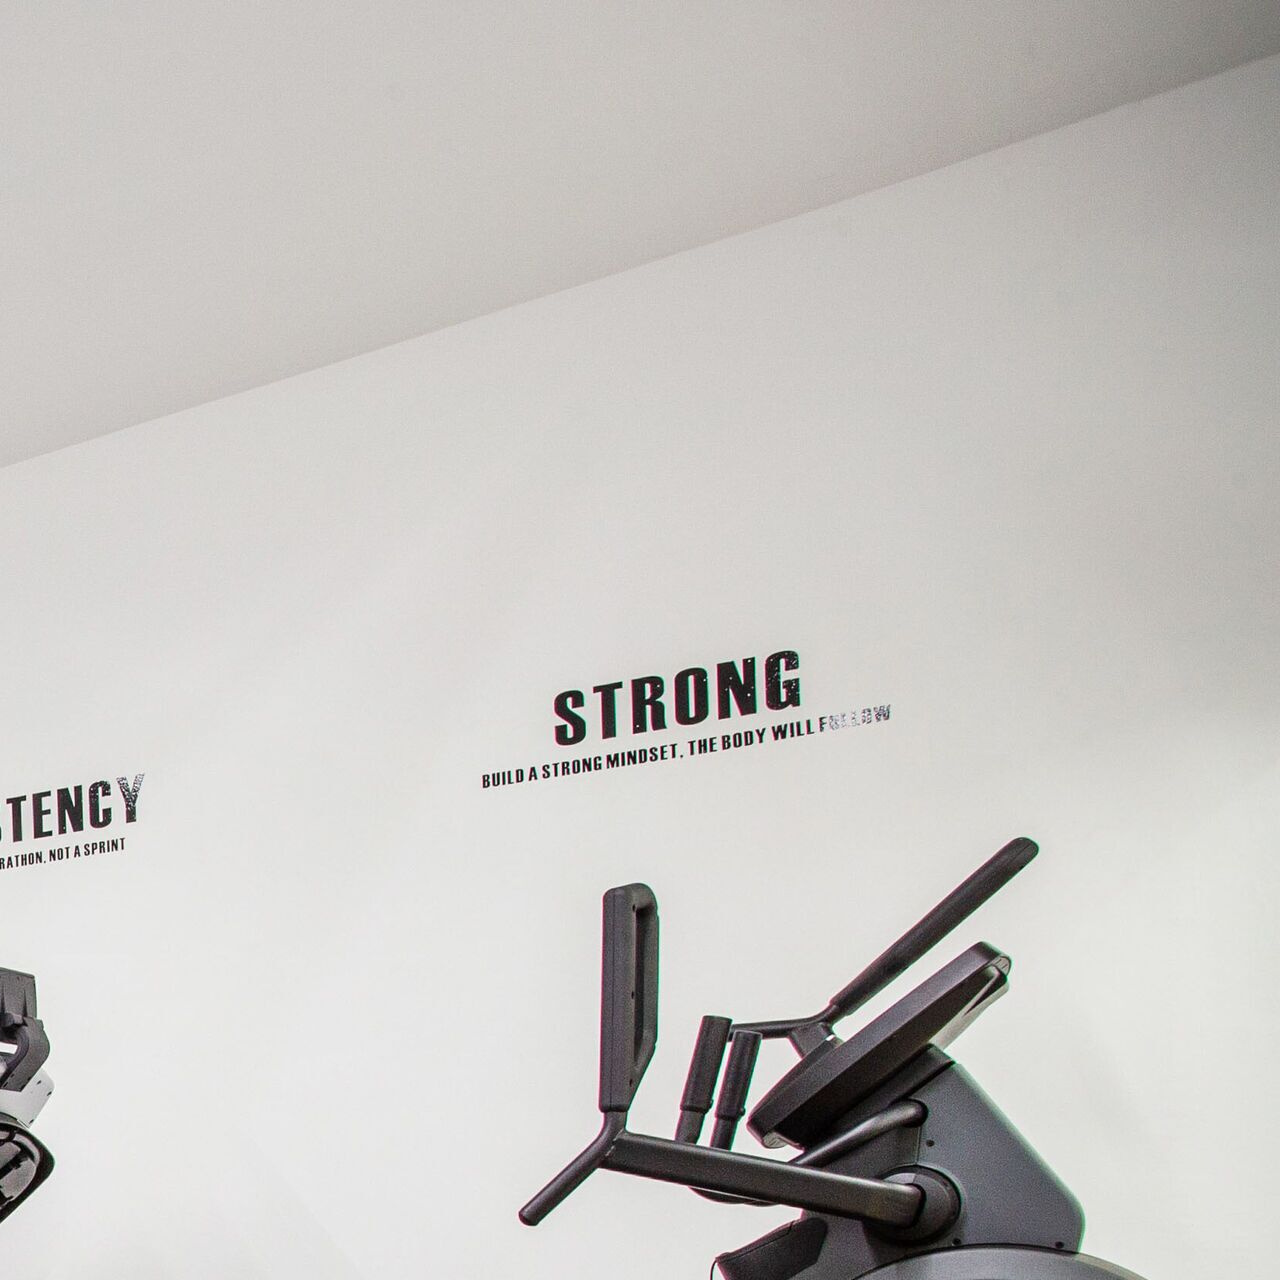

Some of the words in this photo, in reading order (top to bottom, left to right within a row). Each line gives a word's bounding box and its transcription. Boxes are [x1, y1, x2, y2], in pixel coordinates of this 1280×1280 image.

[554, 651, 801, 746] STRONG
[482, 769, 524, 788] BUILD
[529, 767, 538, 781] A
[542, 756, 602, 779] STRONG
[606, 743, 683, 769] MINDSET.
[688, 737, 717, 755] THE
[722, 728, 766, 750] BODY
[772, 720, 814, 740] WILL
[49, 847, 70, 862] NOT
[74, 845, 81, 858] A
[84, 838, 125, 856] SPRINT
